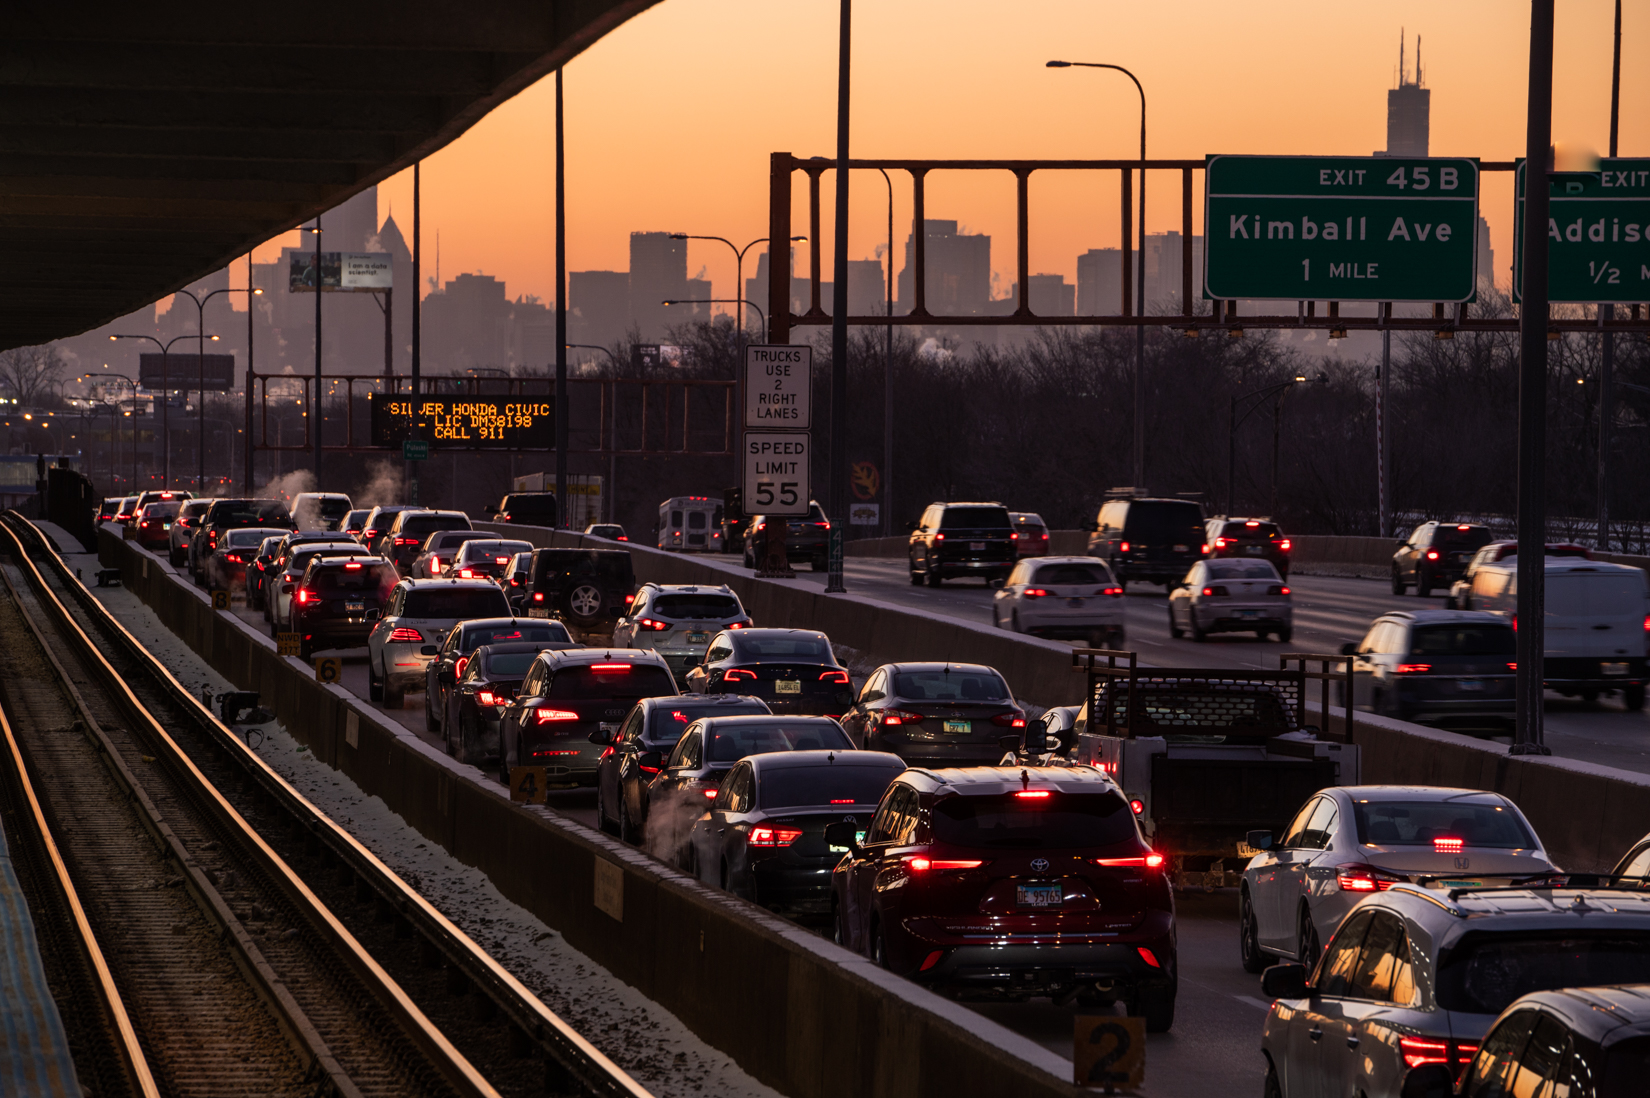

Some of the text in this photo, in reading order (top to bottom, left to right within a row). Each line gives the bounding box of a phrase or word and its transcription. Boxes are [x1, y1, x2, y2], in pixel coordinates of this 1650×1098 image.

[1320, 169, 1366, 185] EXIT
[1601, 171, 1650, 188] EXIT
[1230, 214, 1452, 242] Kimball Ave
[371, 262, 388, 270] data
[1302, 258, 1379, 281] 1 MILE
[753, 350, 801, 362] TRUCKS
[766, 365, 791, 377] USE
[774, 379, 782, 390] 2
[759, 393, 797, 405] RIGHT
[452, 403, 497, 416] HONDA
[505, 403, 550, 416] CIVIC
[757, 408, 799, 419] LANES
[434, 415, 462, 427] LIC
[470, 415, 532, 428] DM38198
[434, 427, 504, 439] CALL 911
[750, 442, 805, 454] SPEED
[756, 462, 798, 475] LIMIT
[756, 482, 799, 506] 55
[215, 591, 228, 608] 8
[277, 634, 300, 643] NWD
[277, 646, 300, 656] 217T
[320, 659, 337, 681] 6
[518, 772, 538, 797] 4
[1017, 890, 1061, 903] DE 95765
[1088, 1022, 1131, 1083] 2
